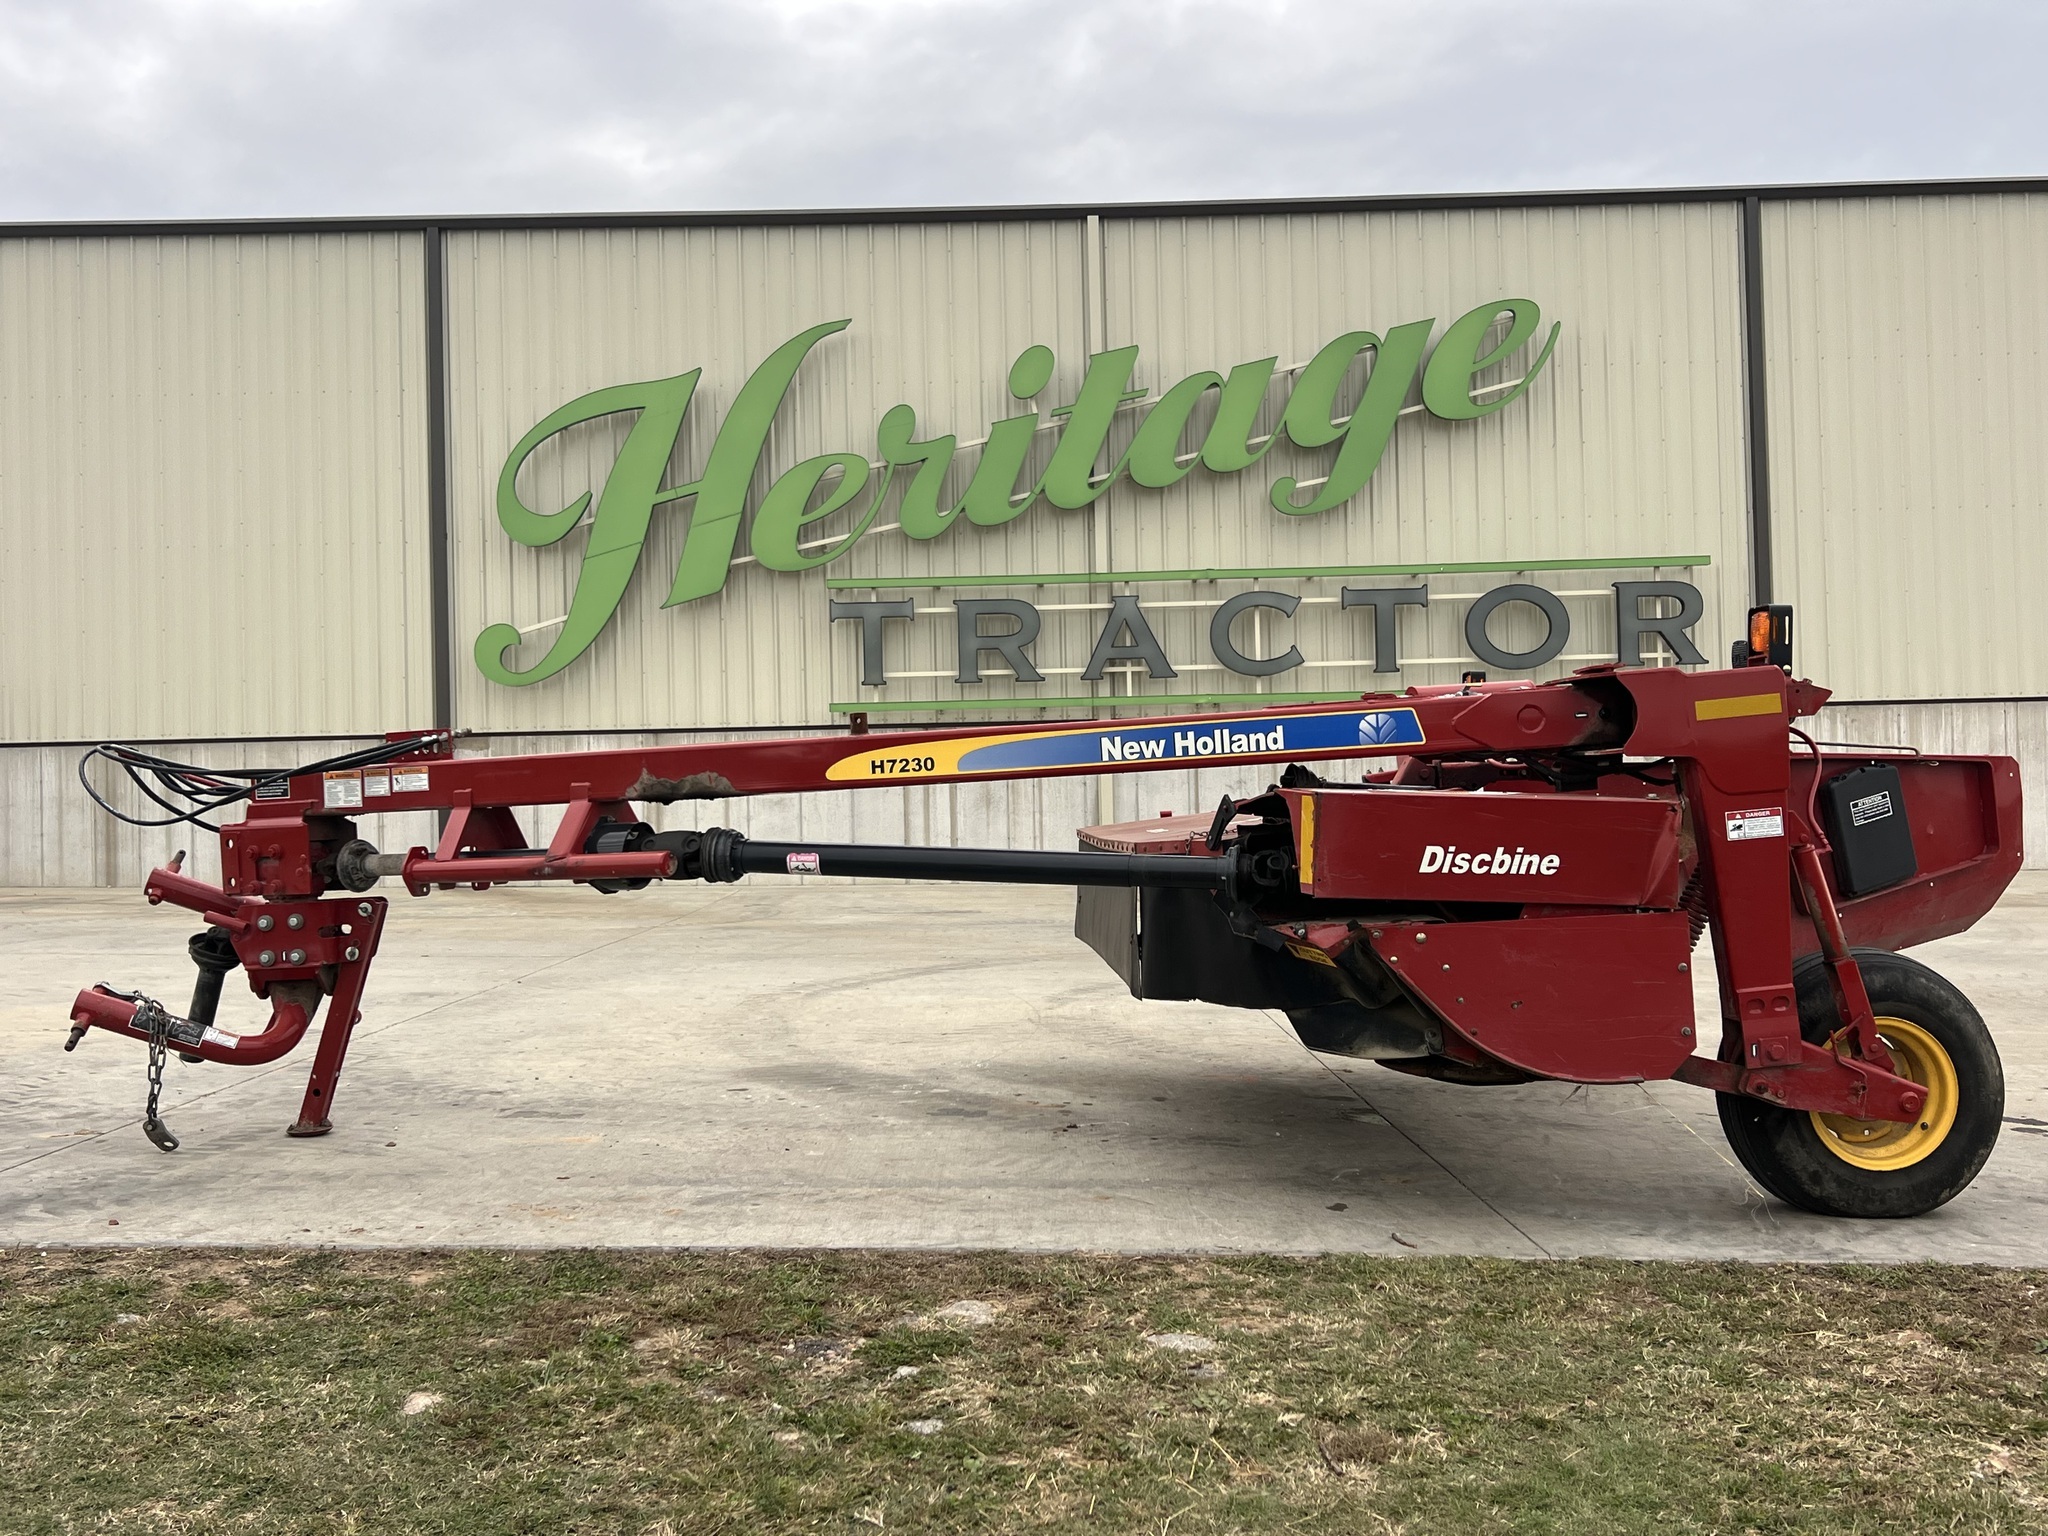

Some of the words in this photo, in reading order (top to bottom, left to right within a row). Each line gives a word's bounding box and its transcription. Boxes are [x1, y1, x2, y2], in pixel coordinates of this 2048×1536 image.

[474, 298, 1561, 687] Heritage
[830, 581, 1708, 687] TRACTOR
[1100, 735, 1166, 762] New
[1175, 726, 1285, 757] Holland
[870, 757, 936, 776] H7230
[1745, 810, 1771, 818] DANGER
[1857, 795, 1883, 807] ATTENTION
[1418, 845, 1560, 876] Discbine
